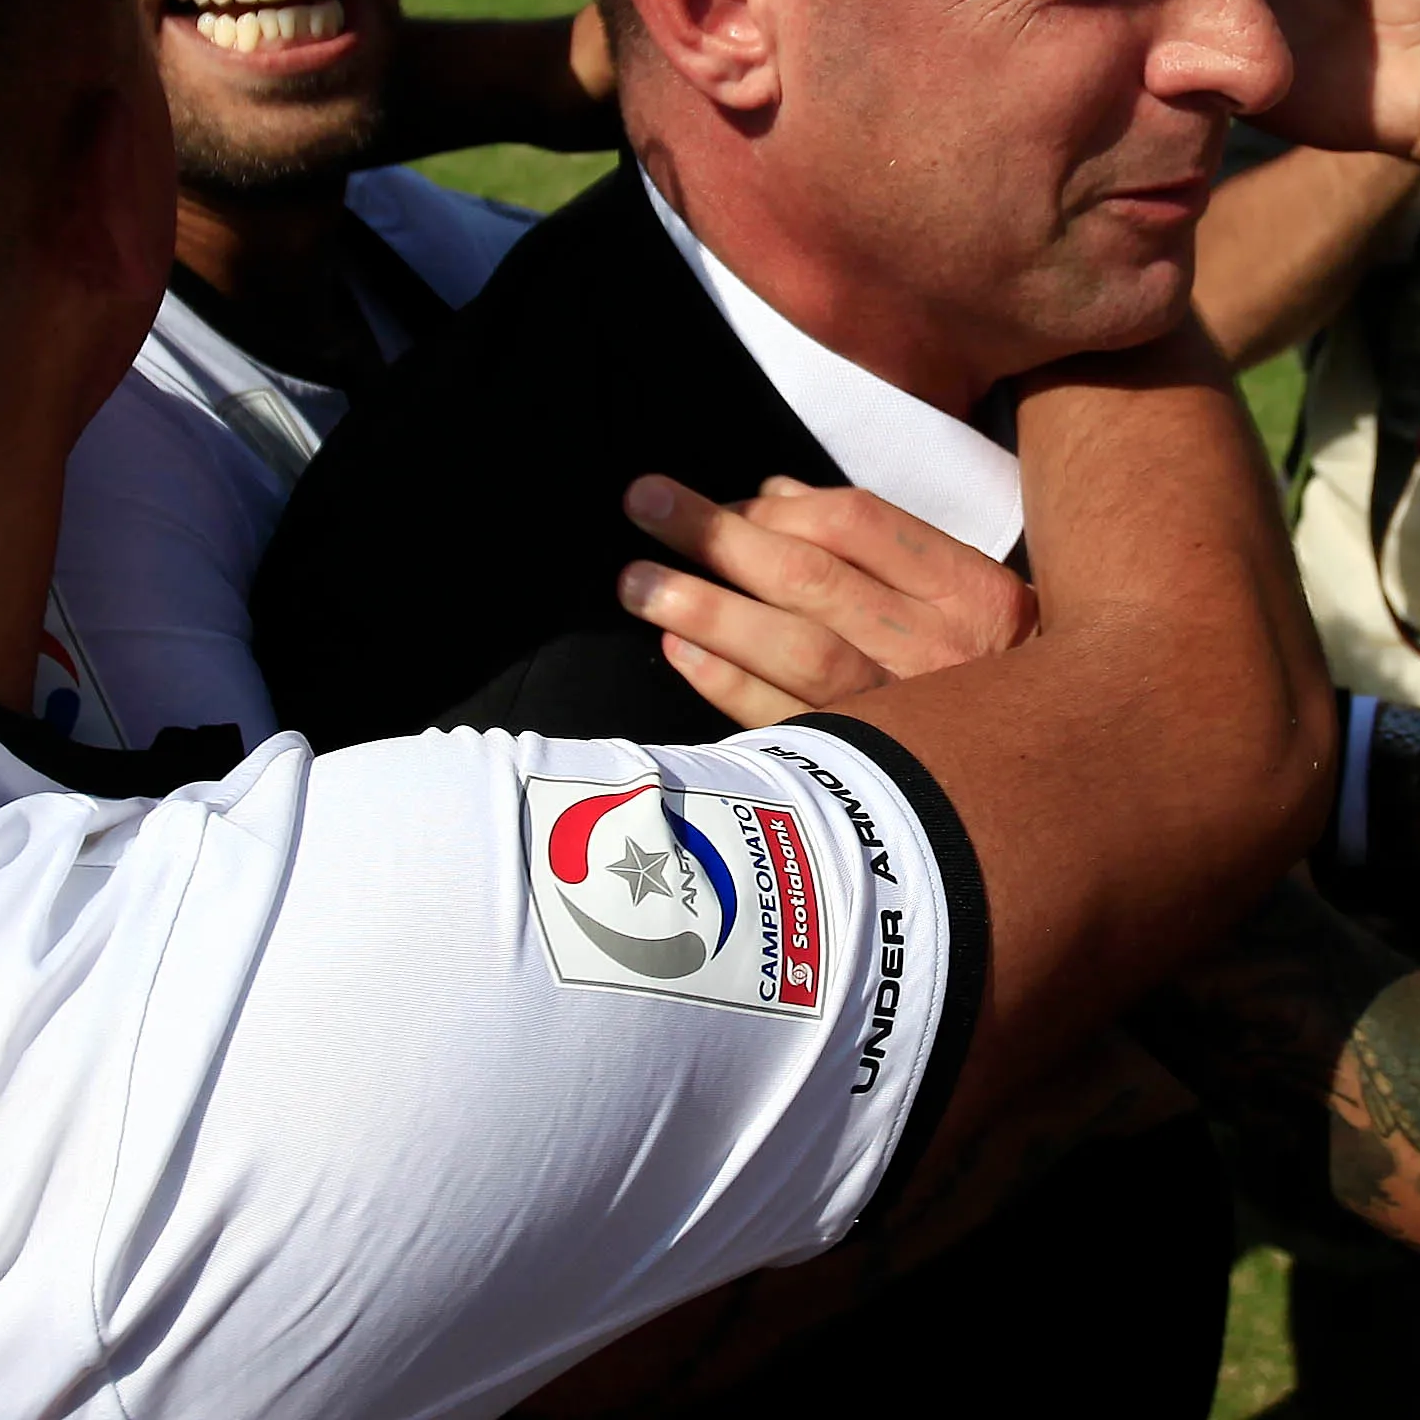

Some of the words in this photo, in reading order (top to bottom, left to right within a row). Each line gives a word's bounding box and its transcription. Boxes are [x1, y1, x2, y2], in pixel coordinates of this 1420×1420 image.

[759, 746, 899, 885] ARMOUR
[770, 818, 810, 950] Scotiabank
[732, 804, 780, 1002] CAMPEONATO
[850, 908, 905, 1097] UNDER
